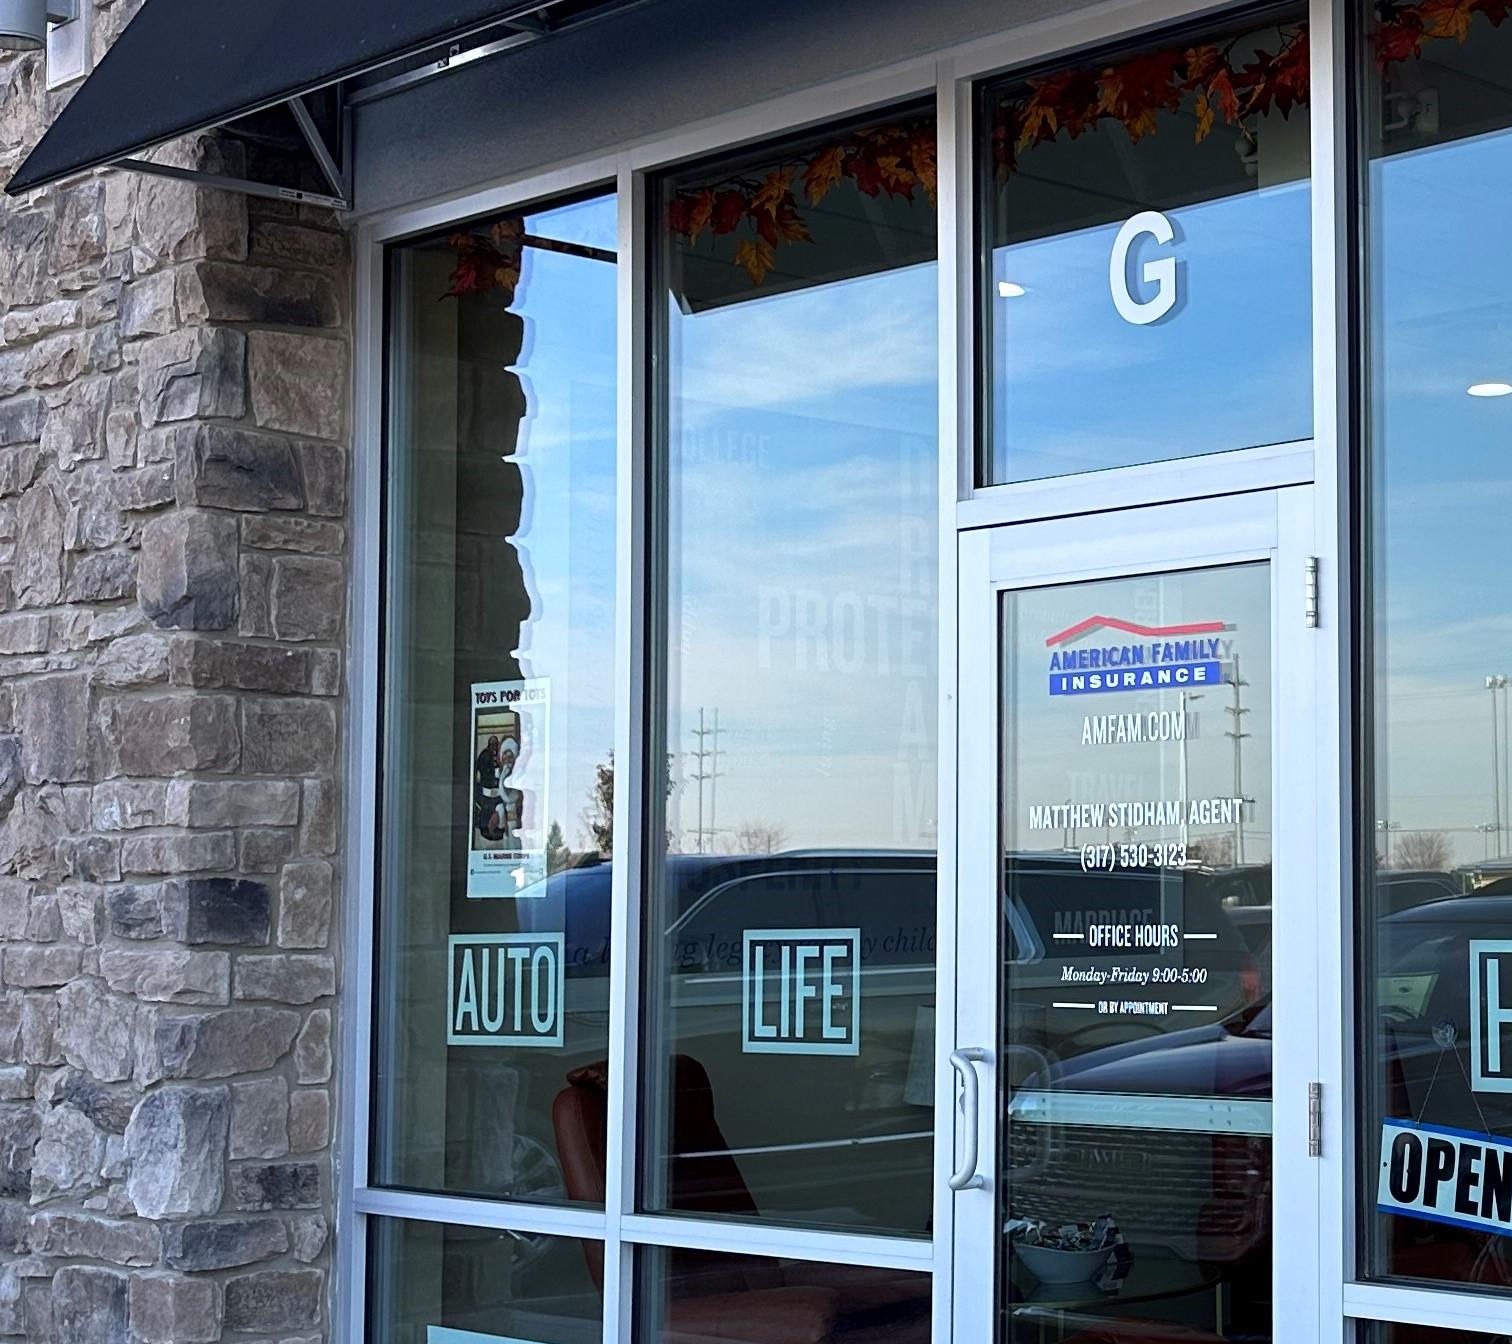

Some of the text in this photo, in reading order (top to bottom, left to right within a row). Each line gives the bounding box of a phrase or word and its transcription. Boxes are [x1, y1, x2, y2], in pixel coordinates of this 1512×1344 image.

[1109, 211, 1177, 325] G
[1050, 638, 1220, 672] AMERICAN FAMILY
[1062, 666, 1207, 691] INSURANCE
[475, 691, 497, 704] TOYS
[500, 689, 520, 703] FOR
[1081, 710, 1186, 746] AMFAM.COM
[1029, 798, 1243, 830] MATTHEW STIDHAM, AGENT
[1080, 842, 1188, 873] (317) 530-3123
[1089, 924, 1179, 948] OFFICE HOURS
[455, 946, 556, 1035] AUTO
[1060, 966, 1208, 986] Monday-Friday 9:00-5:00
[753, 944, 848, 1040] LIFE
[1109, 1000, 1119, 1014] BY
[1119, 1001, 1169, 1015] APPOINTMENT
